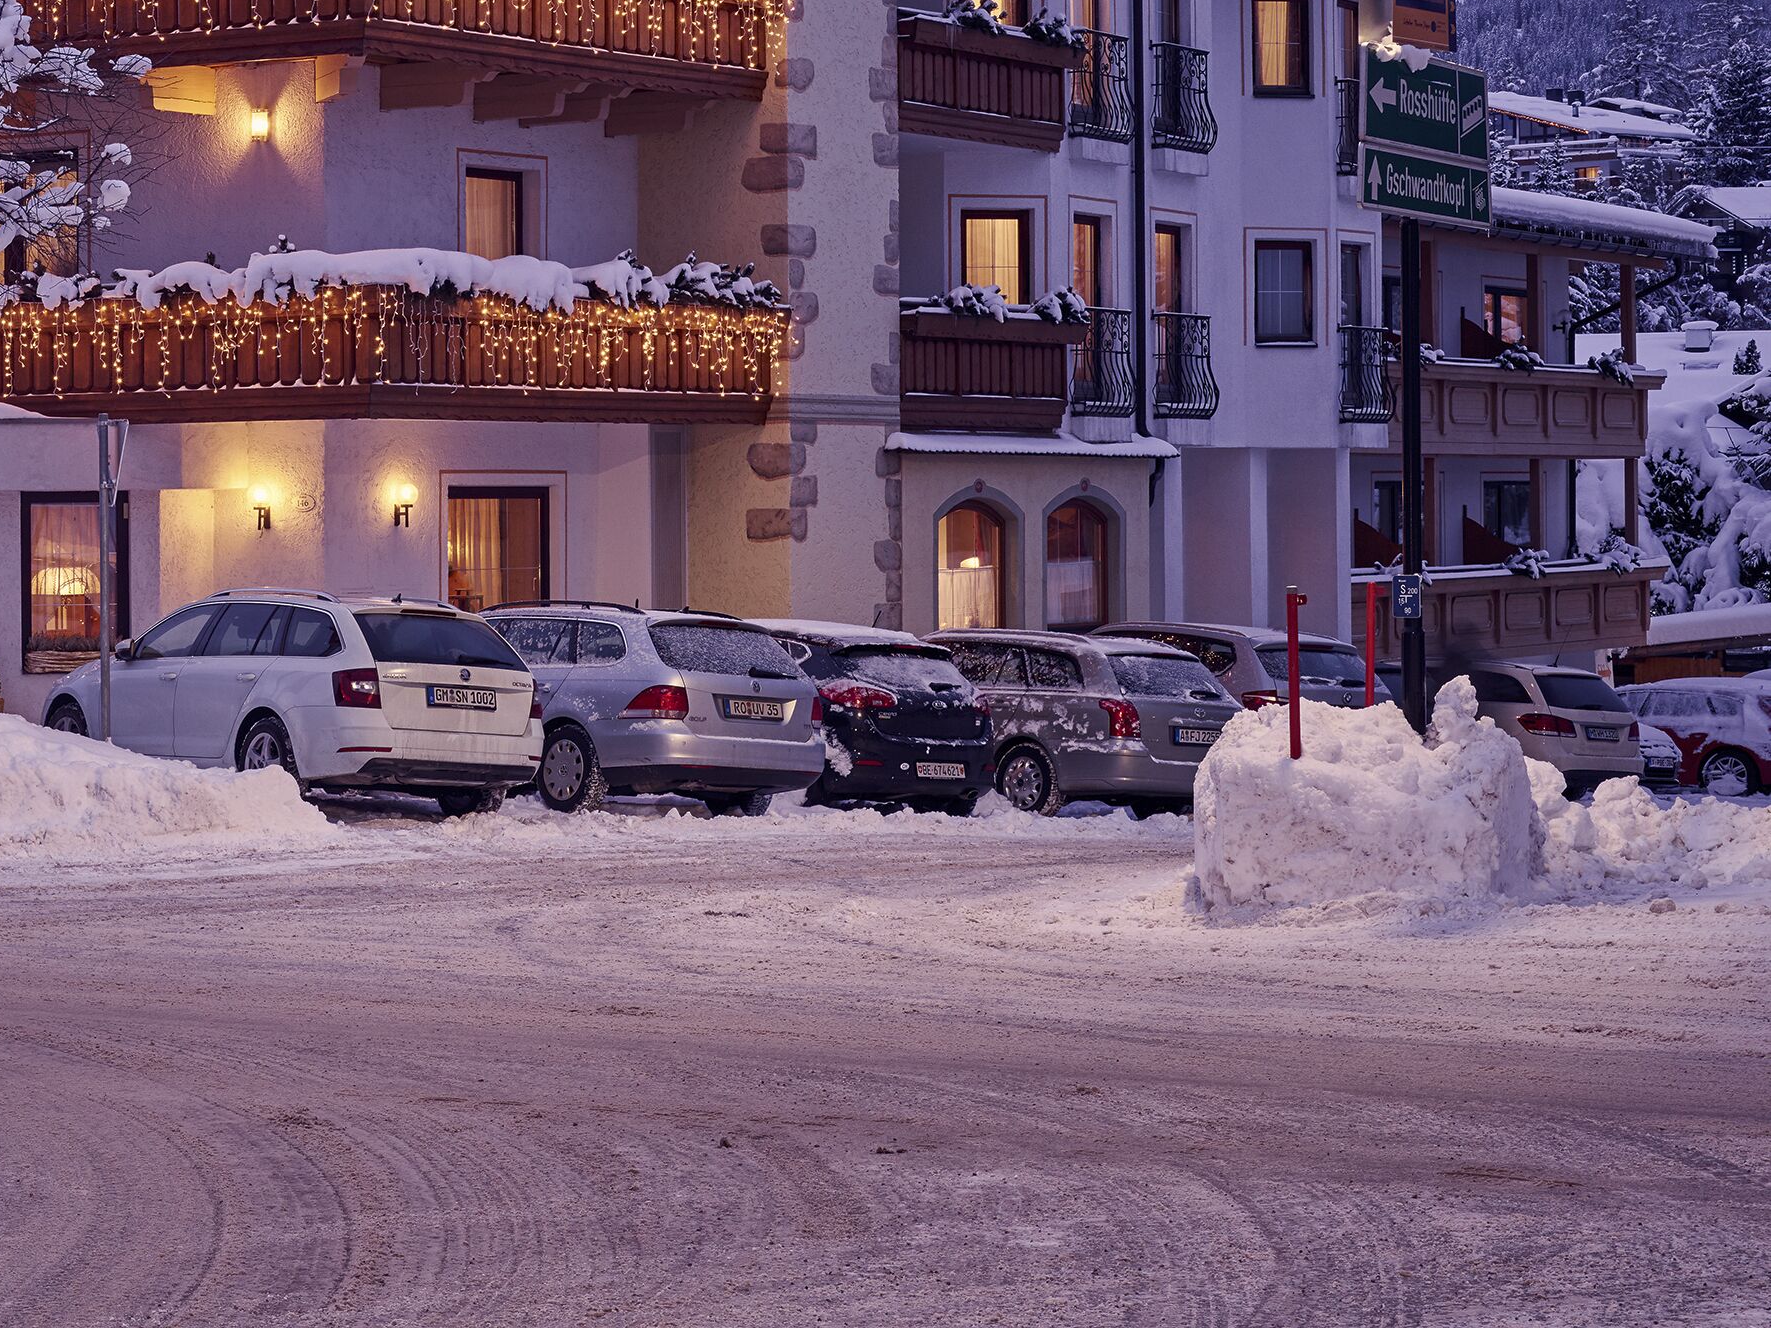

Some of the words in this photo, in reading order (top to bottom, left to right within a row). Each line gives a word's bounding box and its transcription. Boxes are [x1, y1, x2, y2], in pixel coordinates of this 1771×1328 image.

[1400, 78, 1456, 124] Rosshütte
[1386, 163, 1465, 213] Gschwandtkopf
[1400, 584, 1406, 595] S
[1407, 587, 1418, 595] 200
[435, 688, 449, 702] GM
[455, 690, 469, 704] SN
[470, 691, 495, 706] 1002
[734, 701, 747, 714] RO
[752, 702, 765, 715] UV
[766, 704, 779, 716] 35
[1180, 728, 1186, 742] A
[1190, 730, 1201, 742] FJ
[922, 765, 932, 775] BE
